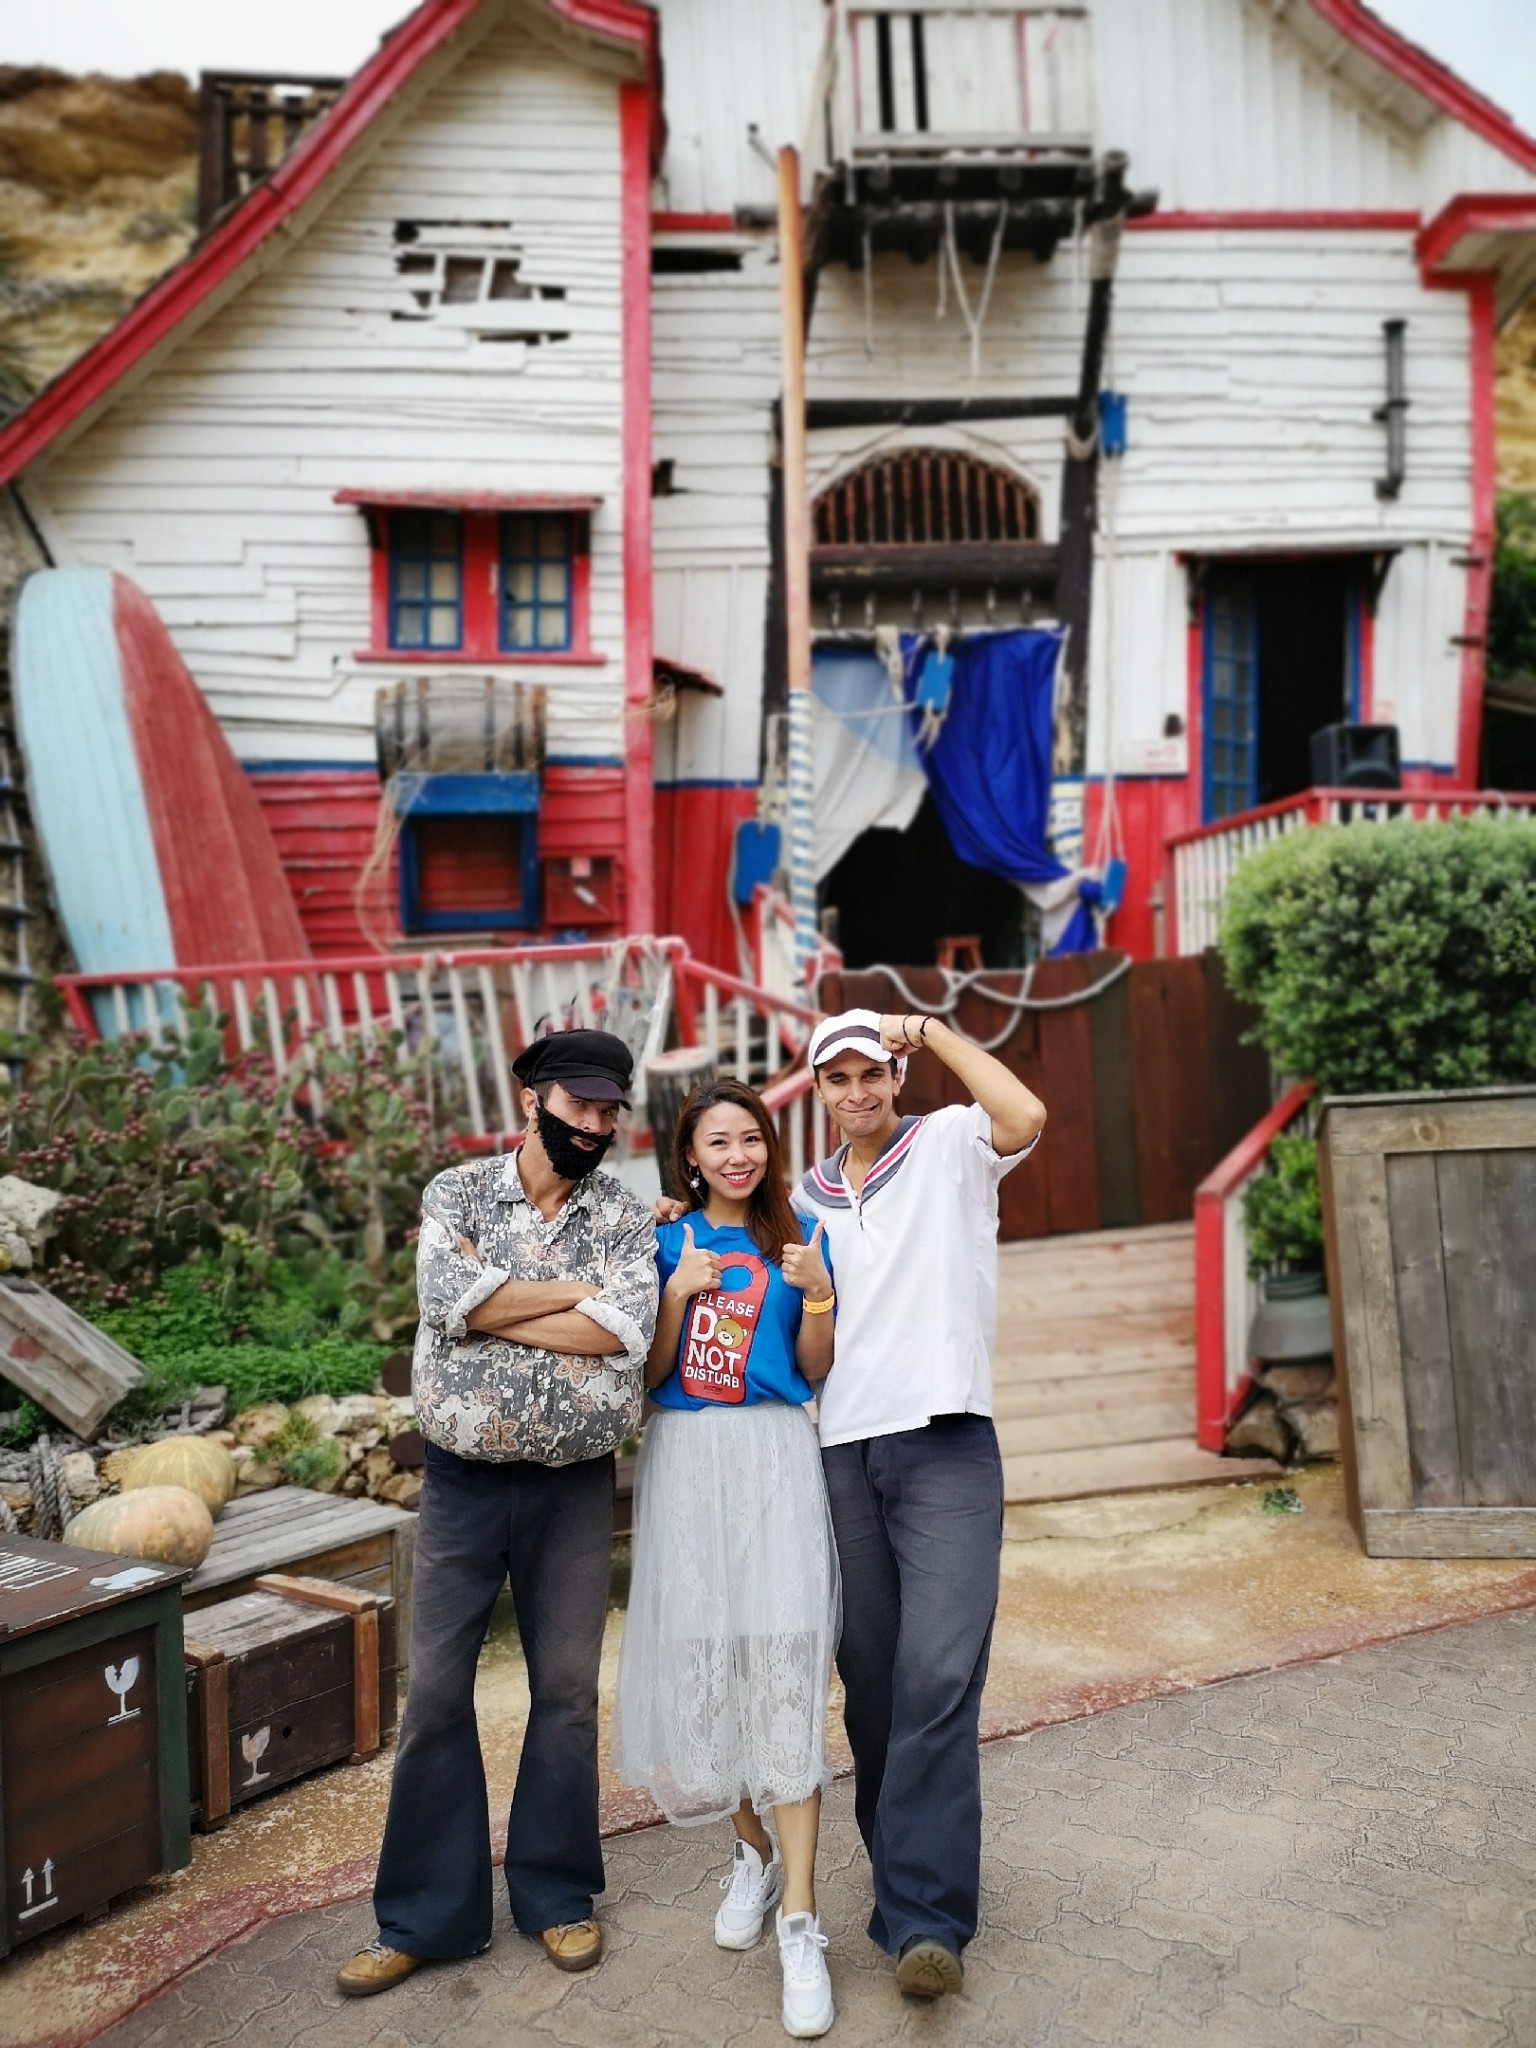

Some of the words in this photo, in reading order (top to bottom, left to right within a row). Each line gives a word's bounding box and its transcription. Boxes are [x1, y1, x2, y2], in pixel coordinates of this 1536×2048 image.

[698, 1291, 755, 1318] PLEASE
[687, 1340, 742, 1375] NOT
[684, 1365, 740, 1389] DISTURB
